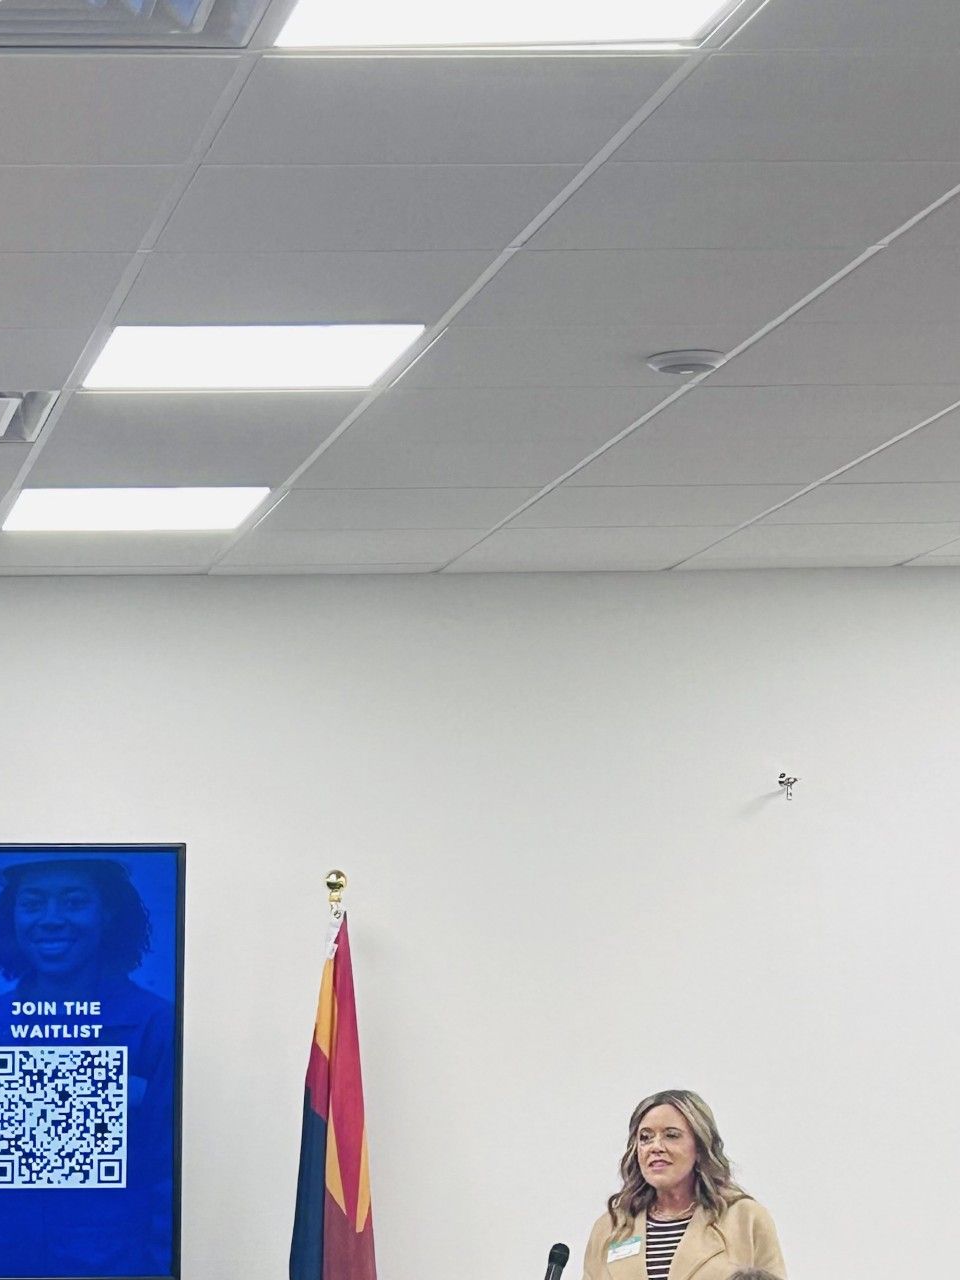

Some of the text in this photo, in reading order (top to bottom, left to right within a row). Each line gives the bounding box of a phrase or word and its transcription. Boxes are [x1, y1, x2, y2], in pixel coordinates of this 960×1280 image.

[11, 1001, 101, 1016] JOIN THE
[10, 1024, 103, 1038] WAITLIST
